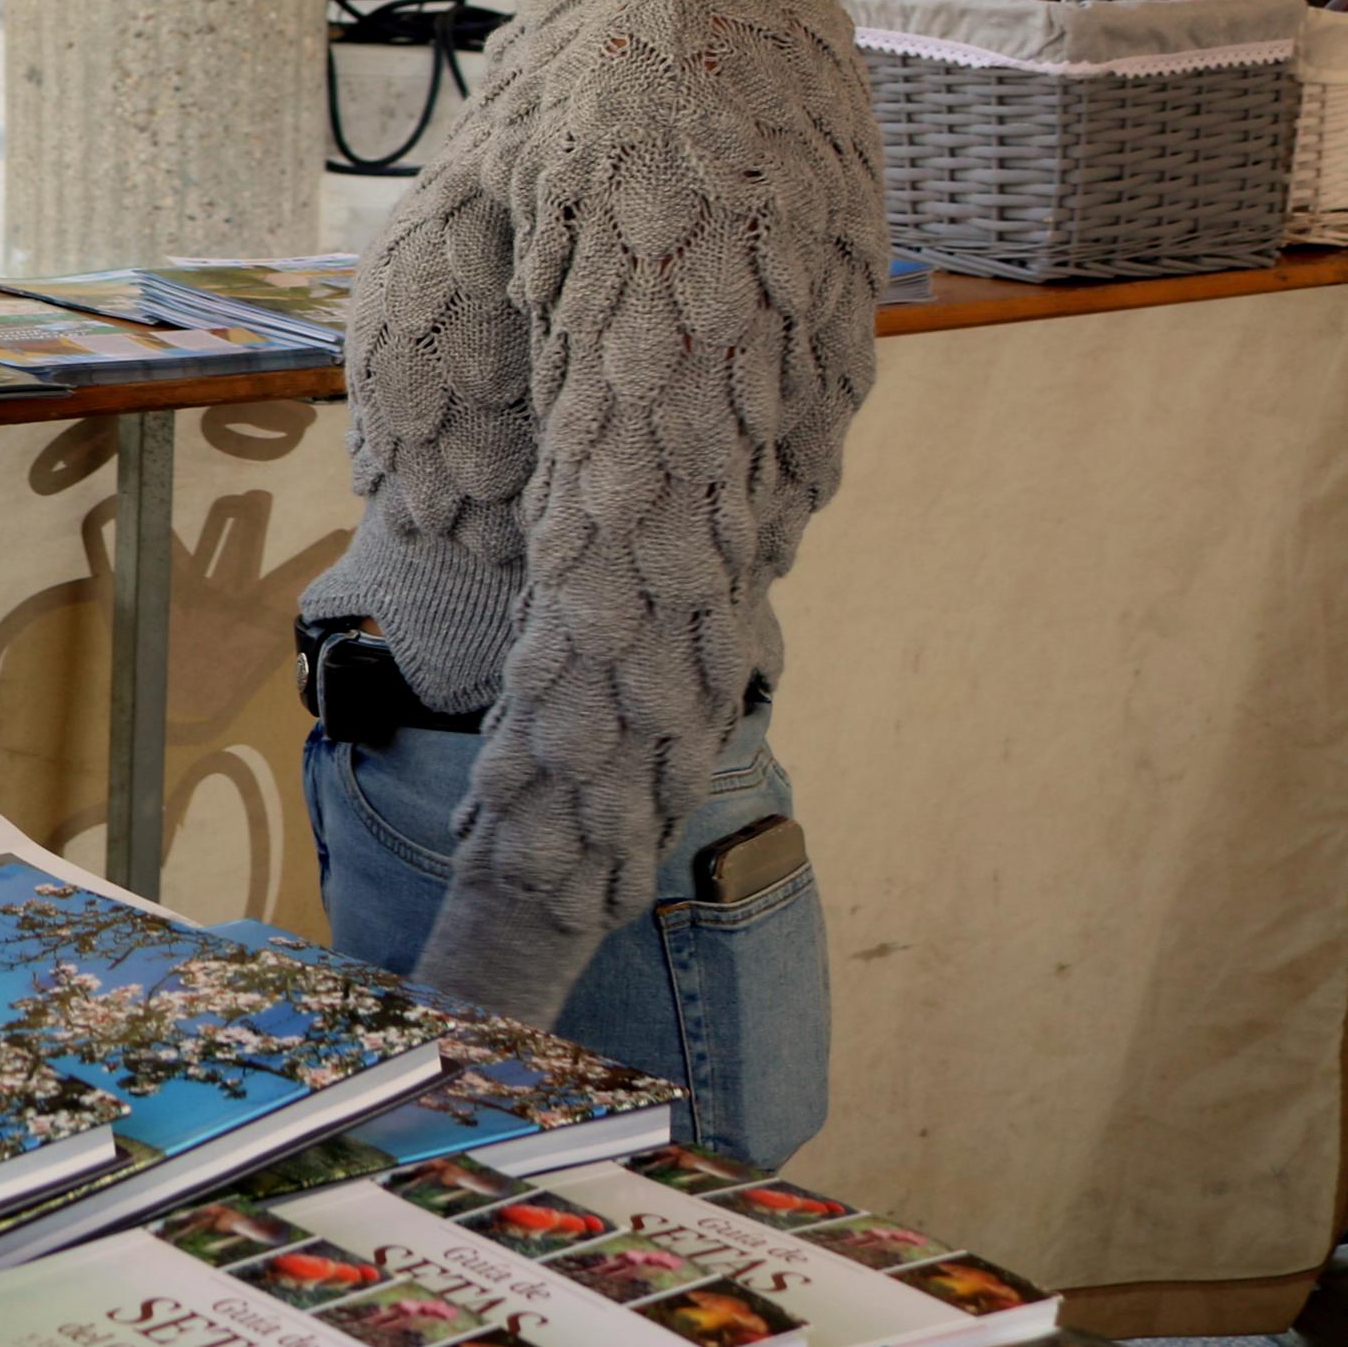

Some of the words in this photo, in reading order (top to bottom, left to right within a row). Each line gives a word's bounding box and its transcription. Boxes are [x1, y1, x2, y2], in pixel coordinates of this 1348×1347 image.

[628, 1212, 813, 1293] SETAS
[696, 1217, 767, 1247] Guía
[766, 1241, 810, 1266] de
[442, 1245, 513, 1285] Guía
[508, 1278, 553, 1302] de
[212, 1297, 281, 1337] Guía
